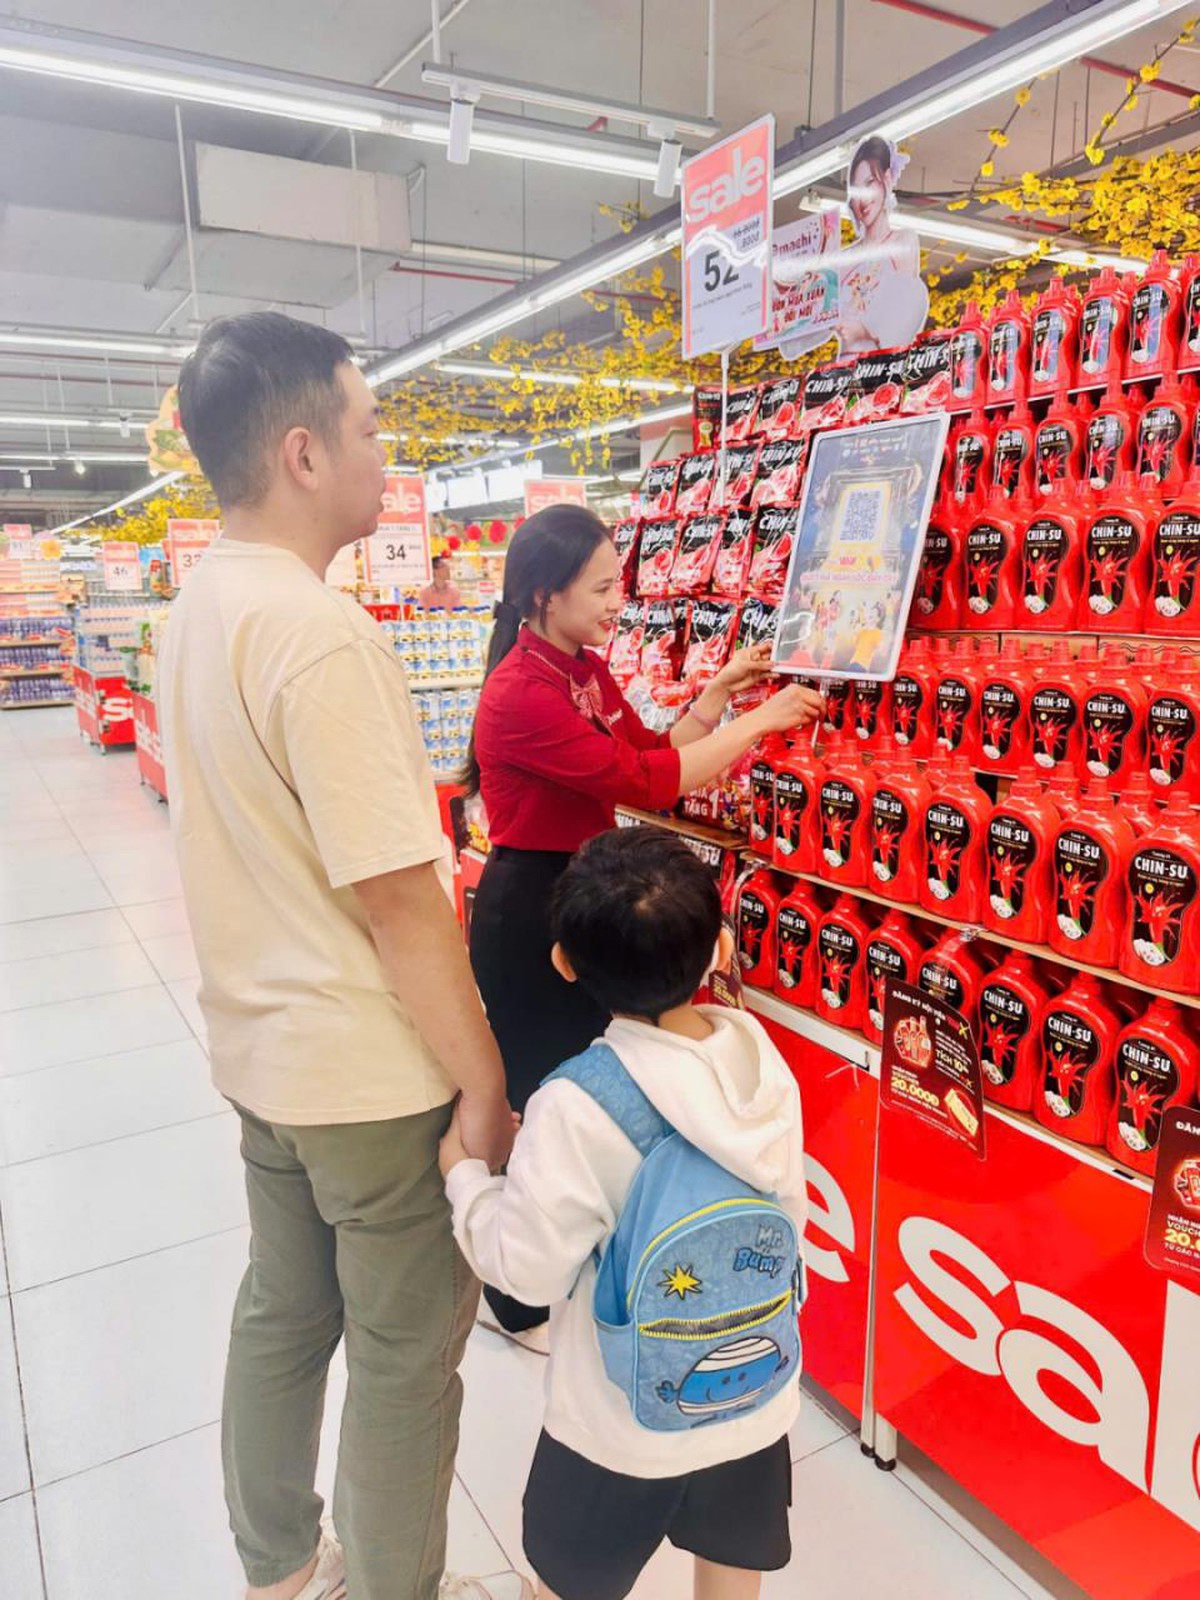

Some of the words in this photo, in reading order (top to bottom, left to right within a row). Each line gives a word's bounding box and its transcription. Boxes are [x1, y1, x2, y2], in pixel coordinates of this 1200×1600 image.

[686, 148, 765, 222] sale
[380, 481, 421, 514] ale
[967, 532, 1002, 545] CHIN-SU
[1026, 528, 1063, 541] CHIN-SU
[1091, 525, 1133, 540] CHIN-SU
[385, 543, 407, 561] 34
[938, 685, 967, 698] CHIN-SU
[983, 690, 1015, 703] CHIN-SU
[1033, 695, 1071, 709] CHIN-SU
[1087, 700, 1126, 714] CHIN-SU
[1150, 705, 1189, 720] CHIN-SU
[708, 788, 720, 820] 1
[822, 787, 855, 803] CHIN-SU
[873, 797, 903, 814] CHIN-SU
[928, 809, 965, 829] CHIN-SU
[990, 822, 1031, 844] CHIN-SU
[1058, 837, 1101, 860] CHIN-SU
[1134, 856, 1190, 880] CHIN-SU
[779, 911, 807, 930] CHIN-SU
[821, 928, 854, 948] CHIN-SU
[868, 946, 902, 967] CHIN-SU
[921, 966, 958, 990] CHIN-SU
[983, 989, 1025, 1015] CHIN-SU
[1047, 1015, 1093, 1044] CHIN-SU
[1121, 1043, 1172, 1074] CHIN-SU
[1175, 1120, 1200, 1135] ĐĂN
[1166, 1219, 1200, 1237] VOUCH
[893, 1215, 1200, 1536] sal
